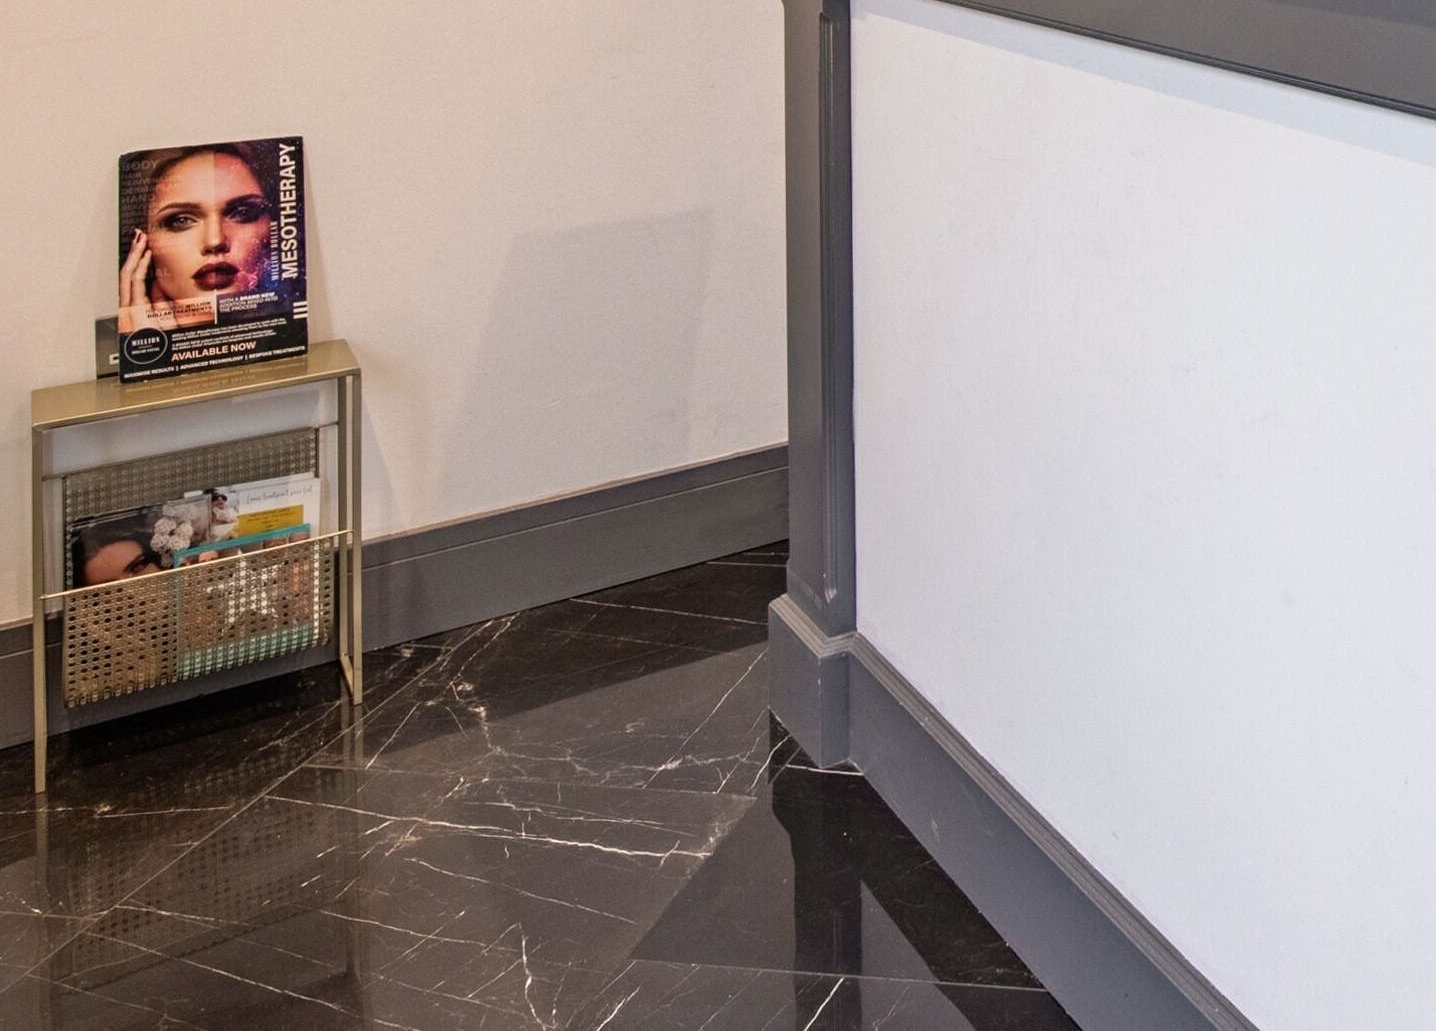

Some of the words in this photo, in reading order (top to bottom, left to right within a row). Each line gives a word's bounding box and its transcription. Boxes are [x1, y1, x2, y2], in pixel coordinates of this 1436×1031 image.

[279, 143, 299, 281] MESOTHERAPY
[171, 344, 229, 362] AVAILABLE
[230, 341, 257, 353] NOW
